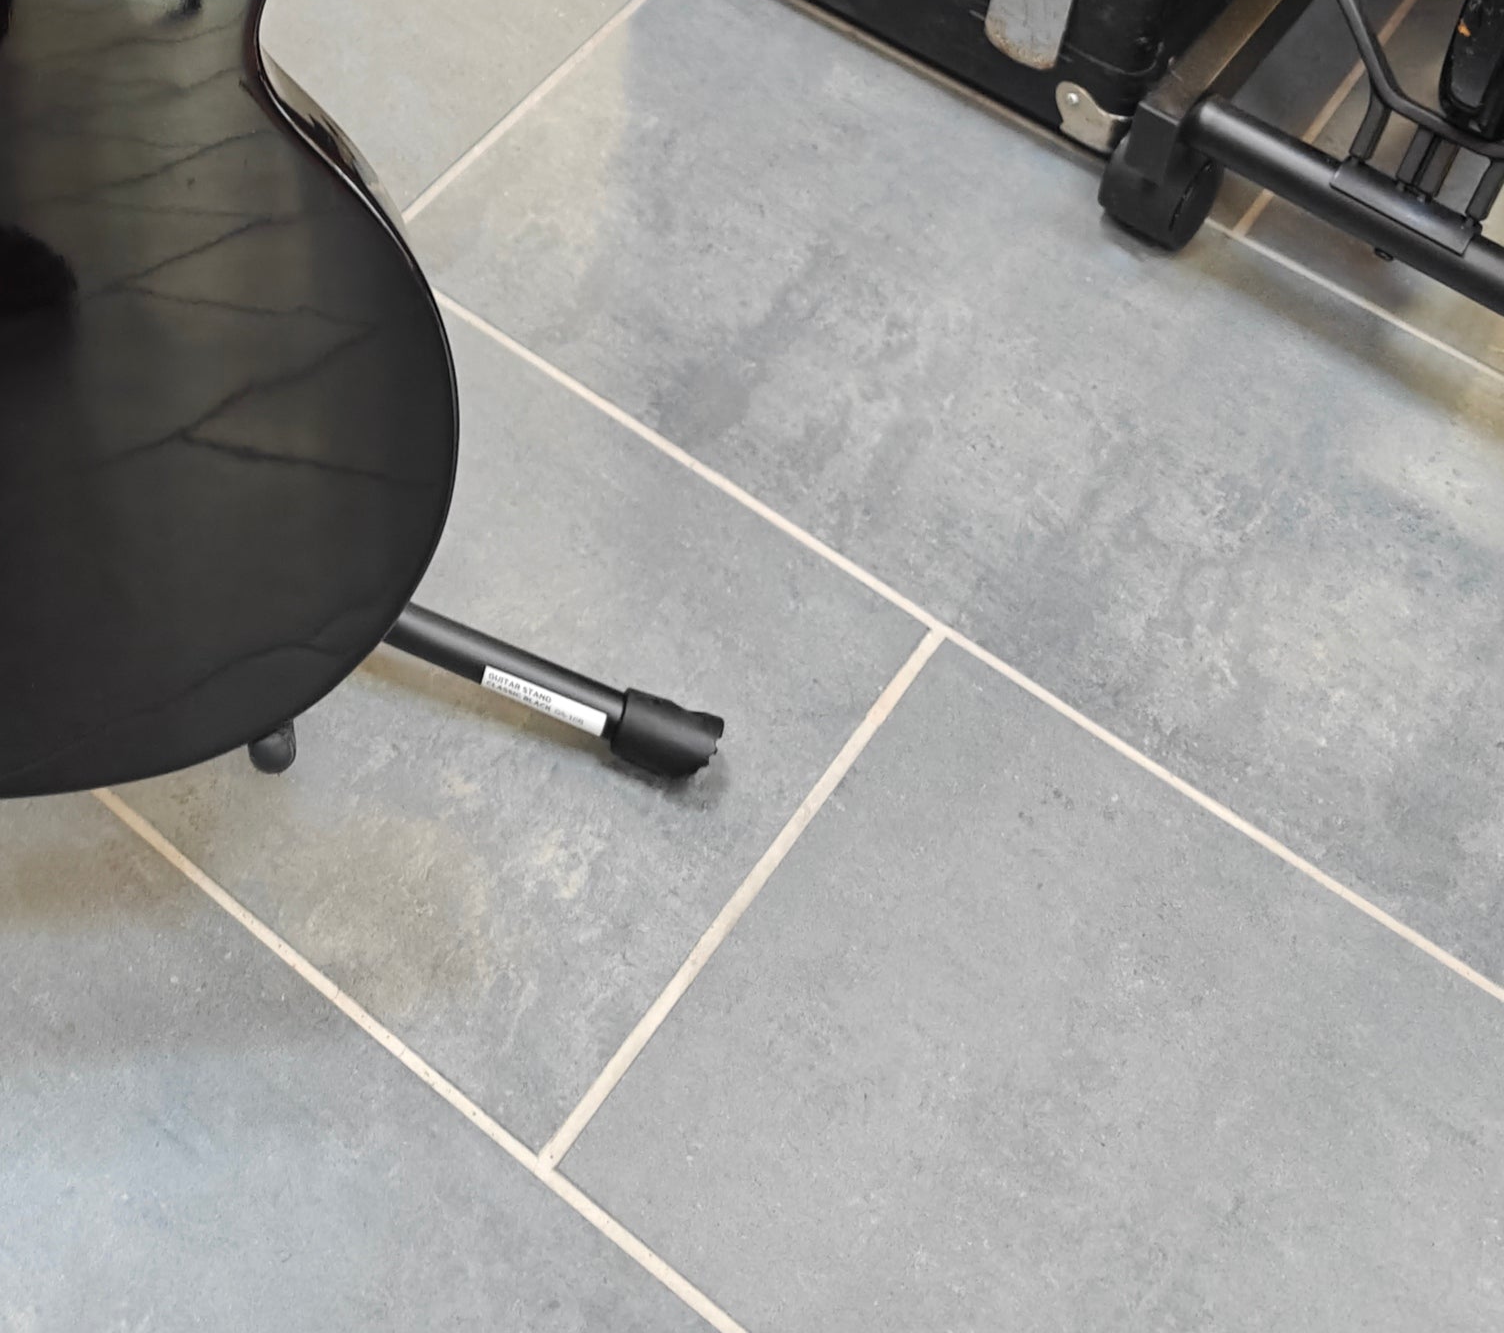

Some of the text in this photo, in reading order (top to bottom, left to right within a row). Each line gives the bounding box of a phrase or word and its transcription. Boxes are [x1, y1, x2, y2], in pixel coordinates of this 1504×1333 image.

[485, 680, 521, 700] CLASSIC
[522, 695, 552, 713] BLACK
[488, 672, 552, 704] GUITAR STAND
